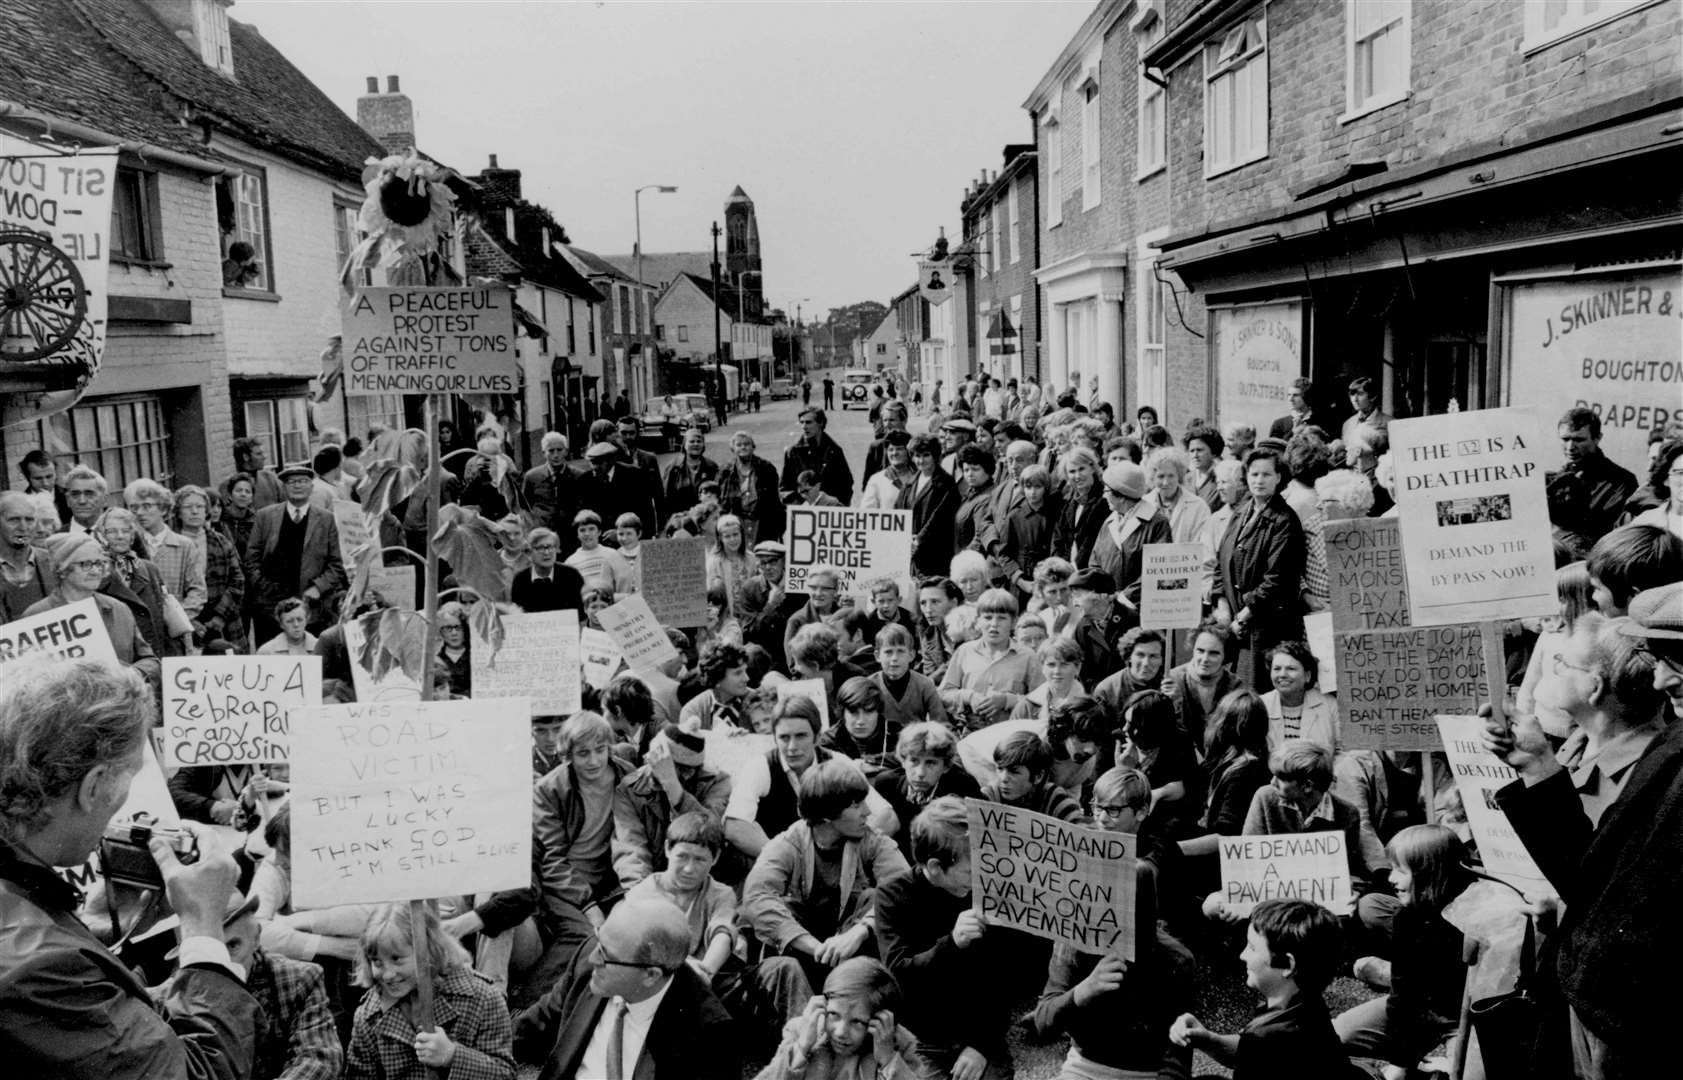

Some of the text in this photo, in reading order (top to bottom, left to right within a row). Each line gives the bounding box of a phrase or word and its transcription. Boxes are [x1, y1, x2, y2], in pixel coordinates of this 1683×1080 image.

[354, 290, 499, 317] A PEACEFUL
[393, 314, 480, 335] PROTEST
[1542, 286, 1673, 348] J. SKINNER &
[353, 335, 508, 354] AGAINST TONS
[351, 355, 457, 372] OF TRAFFIC
[351, 374, 512, 391] MENACING OUR LIVES
[1407, 443, 1451, 462] THE
[1487, 437, 1504, 453] IS
[1512, 434, 1526, 450] A
[1406, 462, 1536, 491] DEATHTRAP
[1429, 539, 1528, 561] DEMAND THE
[1431, 565, 1535, 587] BY PASS NOW!
[1350, 591, 1388, 611] PAY
[1342, 634, 1374, 651] WE
[1382, 630, 1425, 649] HAVE
[1430, 628, 1456, 645] TO
[1344, 651, 1378, 668] FOR
[1382, 649, 1420, 666] THE
[174, 667, 234, 694] Give
[282, 662, 304, 698] A
[1344, 669, 1386, 686] THEY
[1394, 667, 1421, 683] DO
[1427, 666, 1450, 680] TO
[1351, 682, 1489, 702] ROAD & HOMES
[1350, 708, 1382, 723] BAN
[1384, 708, 1438, 721] THEM
[171, 721, 248, 747] or any
[336, 720, 449, 747] ROAD
[1360, 724, 1386, 735] THE
[175, 736, 290, 764] CROSSin
[1454, 740, 1481, 754] THE
[350, 750, 458, 780] VICTIM
[312, 783, 466, 816] BUT I WAS
[366, 807, 454, 828] LUCKY
[979, 807, 1125, 860] WE DEMAND
[310, 838, 393, 862] THANK
[980, 830, 1078, 873] A ROAD
[1224, 835, 1341, 860] WE DEMAND
[337, 859, 384, 879] I'M
[398, 851, 460, 871] STILL
[1263, 862, 1280, 880] A
[980, 853, 1112, 903] SO WE CAN
[1227, 876, 1340, 904] PAVEMENT
[979, 874, 1119, 928] WALK ON A
[982, 895, 1122, 949] PAVEMENT!
